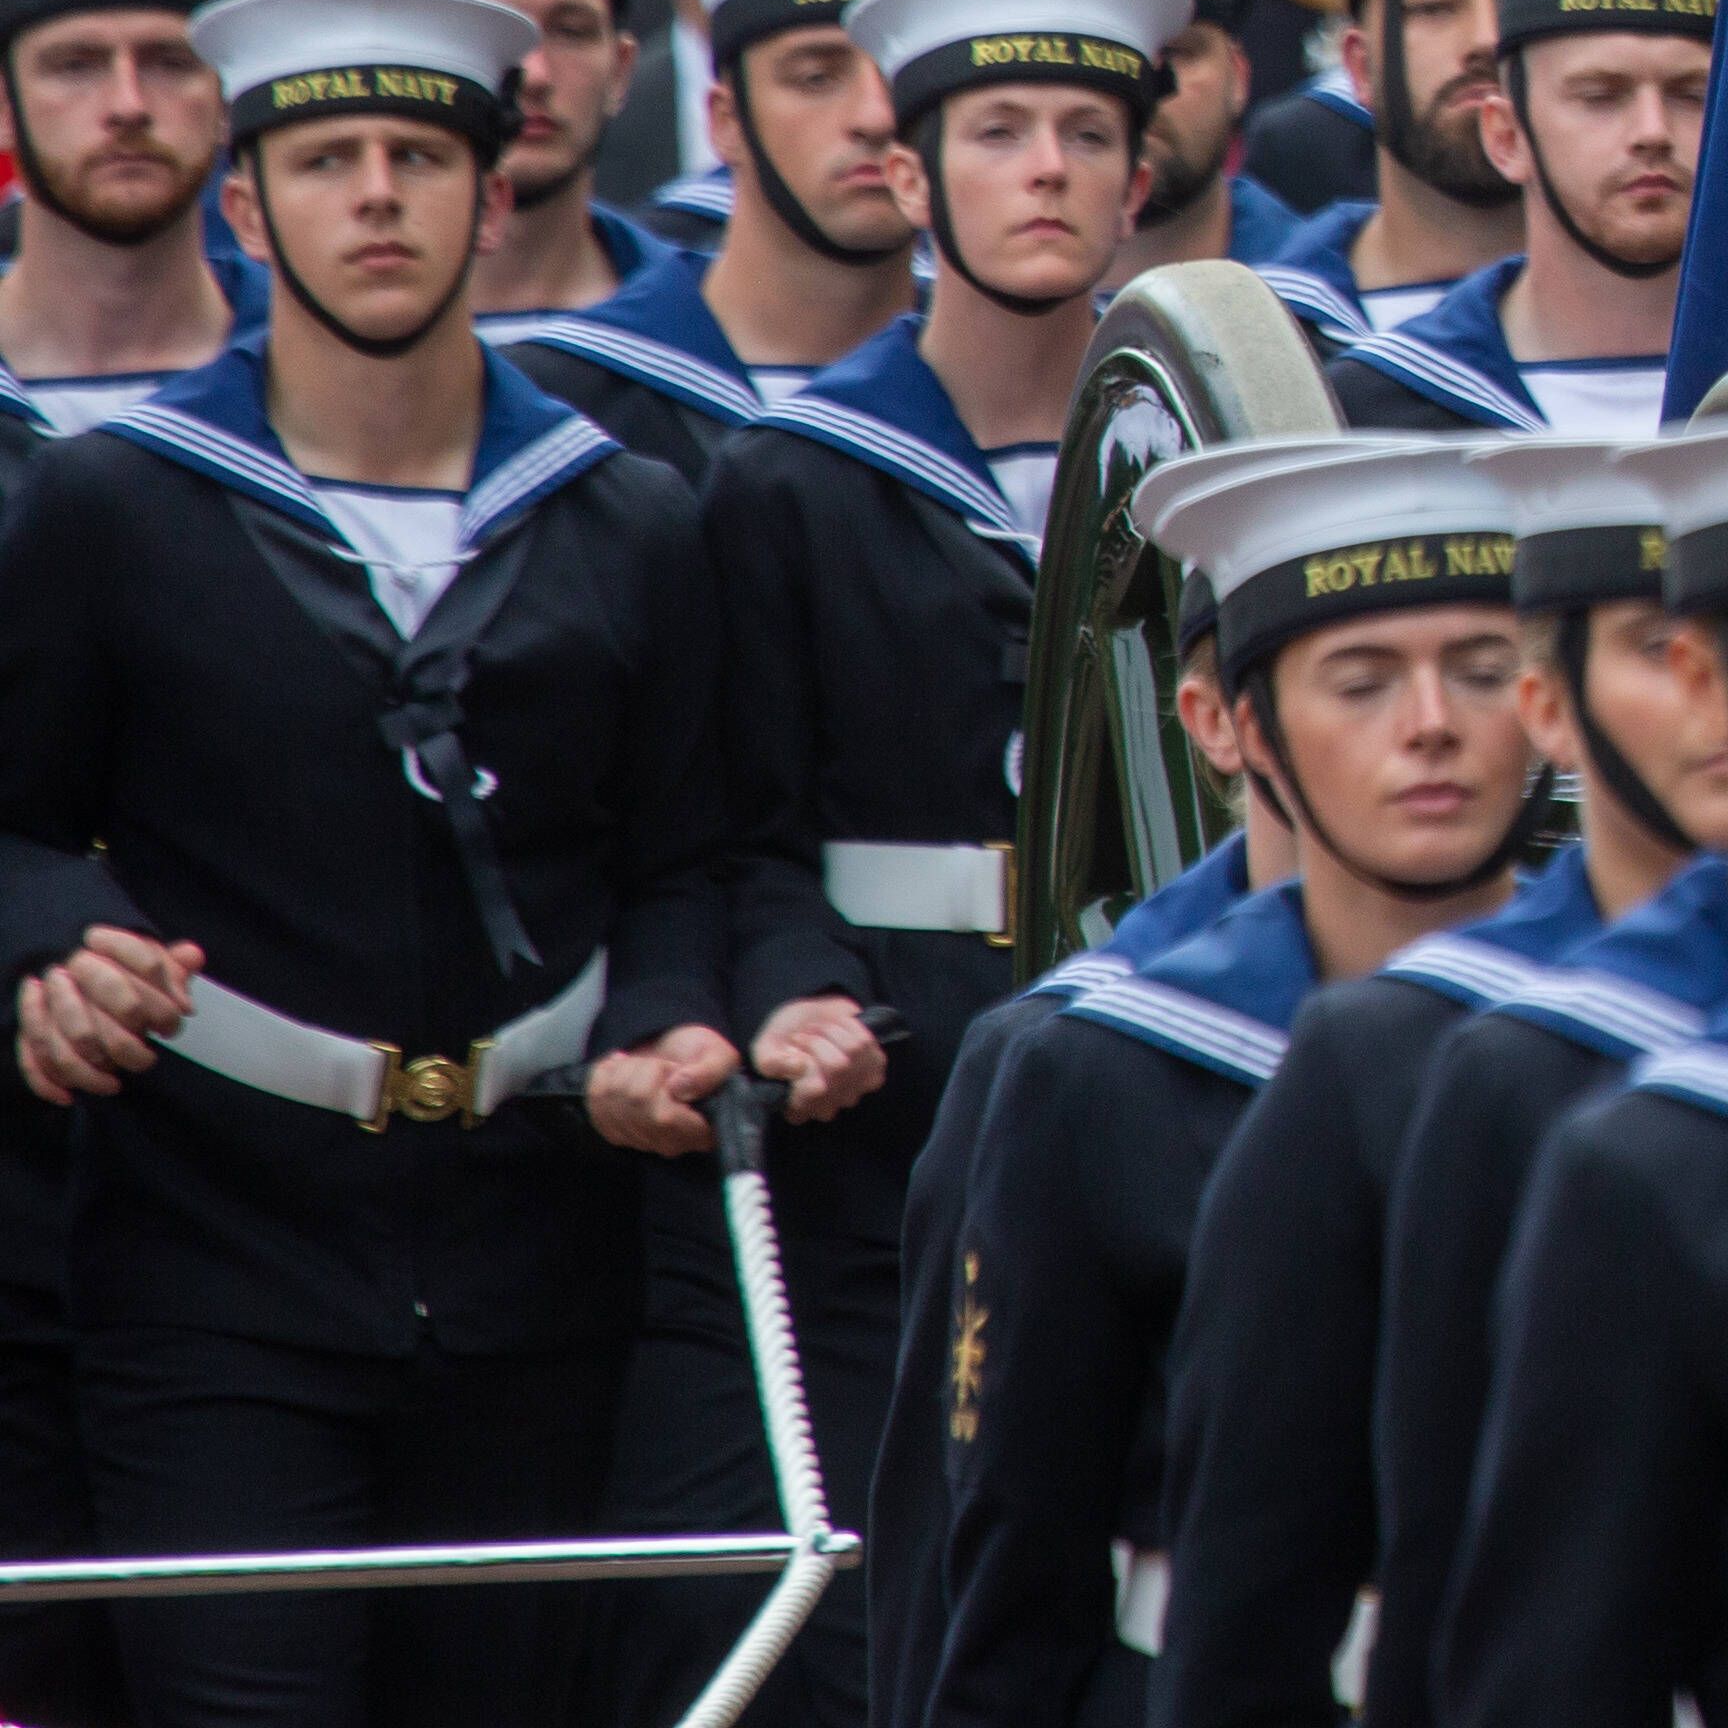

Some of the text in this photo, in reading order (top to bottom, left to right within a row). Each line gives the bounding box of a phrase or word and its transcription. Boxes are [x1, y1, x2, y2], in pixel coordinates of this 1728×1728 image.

[969, 37, 1142, 80] ROYAL NAVY
[271, 69, 460, 109] ROYAL NAVY
[1303, 536, 1517, 598] ROYAL NAV
